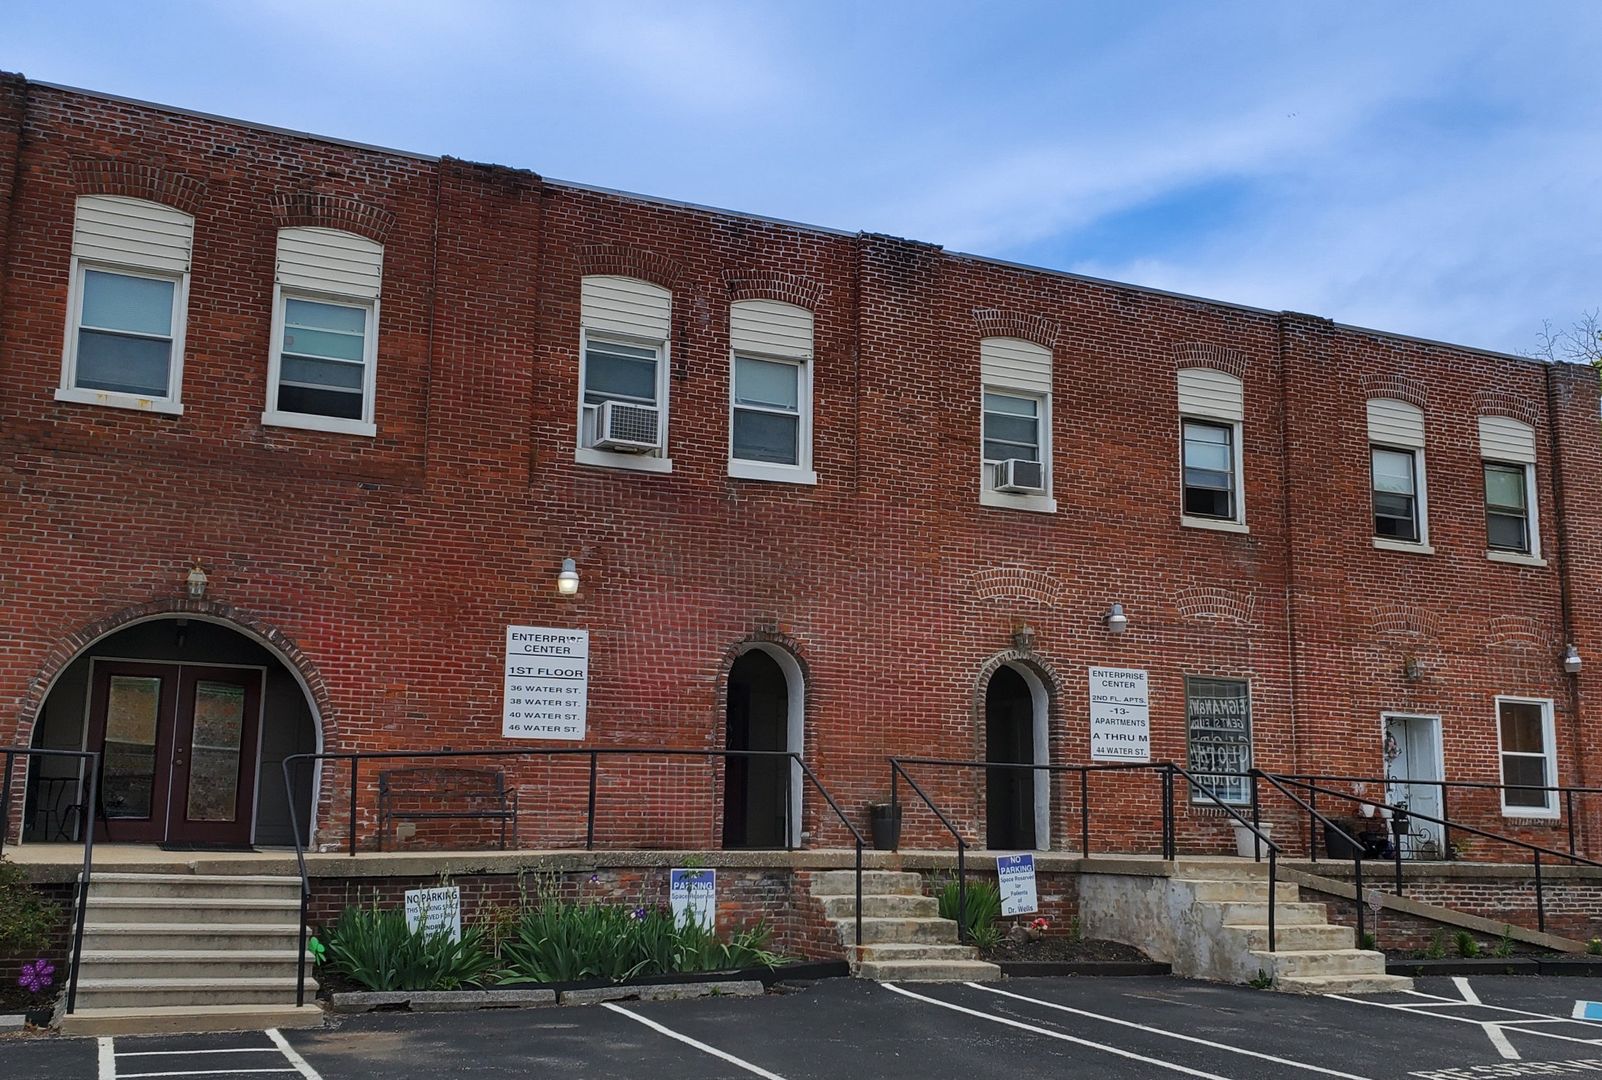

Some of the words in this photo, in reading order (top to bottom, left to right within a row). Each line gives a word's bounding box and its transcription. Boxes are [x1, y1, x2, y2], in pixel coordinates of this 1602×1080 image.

[524, 644, 571, 654] CENTER
[510, 666, 534, 674] 1ST
[538, 668, 584, 677] FLOOR
[1092, 670, 1144, 680] ENTERPRISE
[1095, 718, 1146, 726] APARTMENTS
[1001, 865, 1032, 874] PARKING
[407, 895, 419, 904] NO
[422, 890, 457, 902] PARKING
